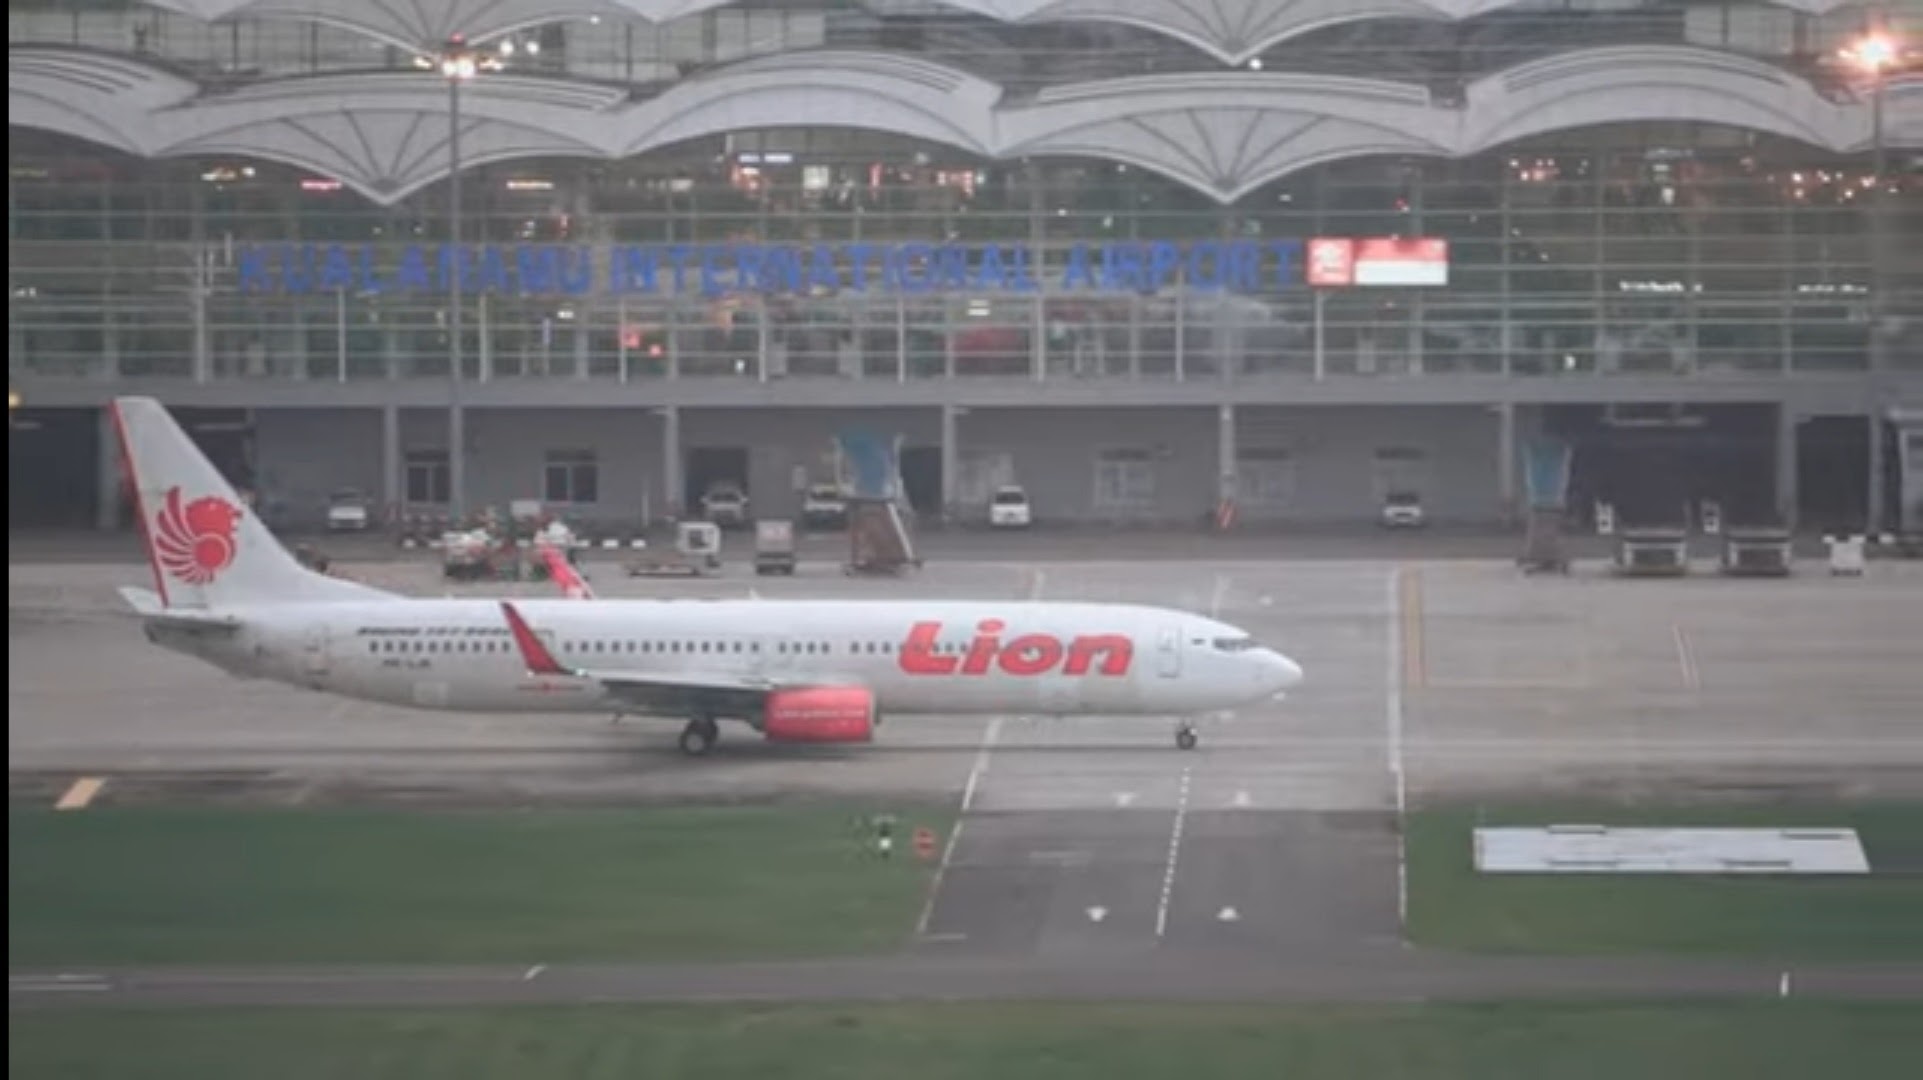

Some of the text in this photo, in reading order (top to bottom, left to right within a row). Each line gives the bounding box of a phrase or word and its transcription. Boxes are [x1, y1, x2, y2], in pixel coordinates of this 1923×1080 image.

[238, 239, 1300, 295] KUALANAMU INTERNATIONAL AIRPORT
[897, 619, 1132, 676] Lion
